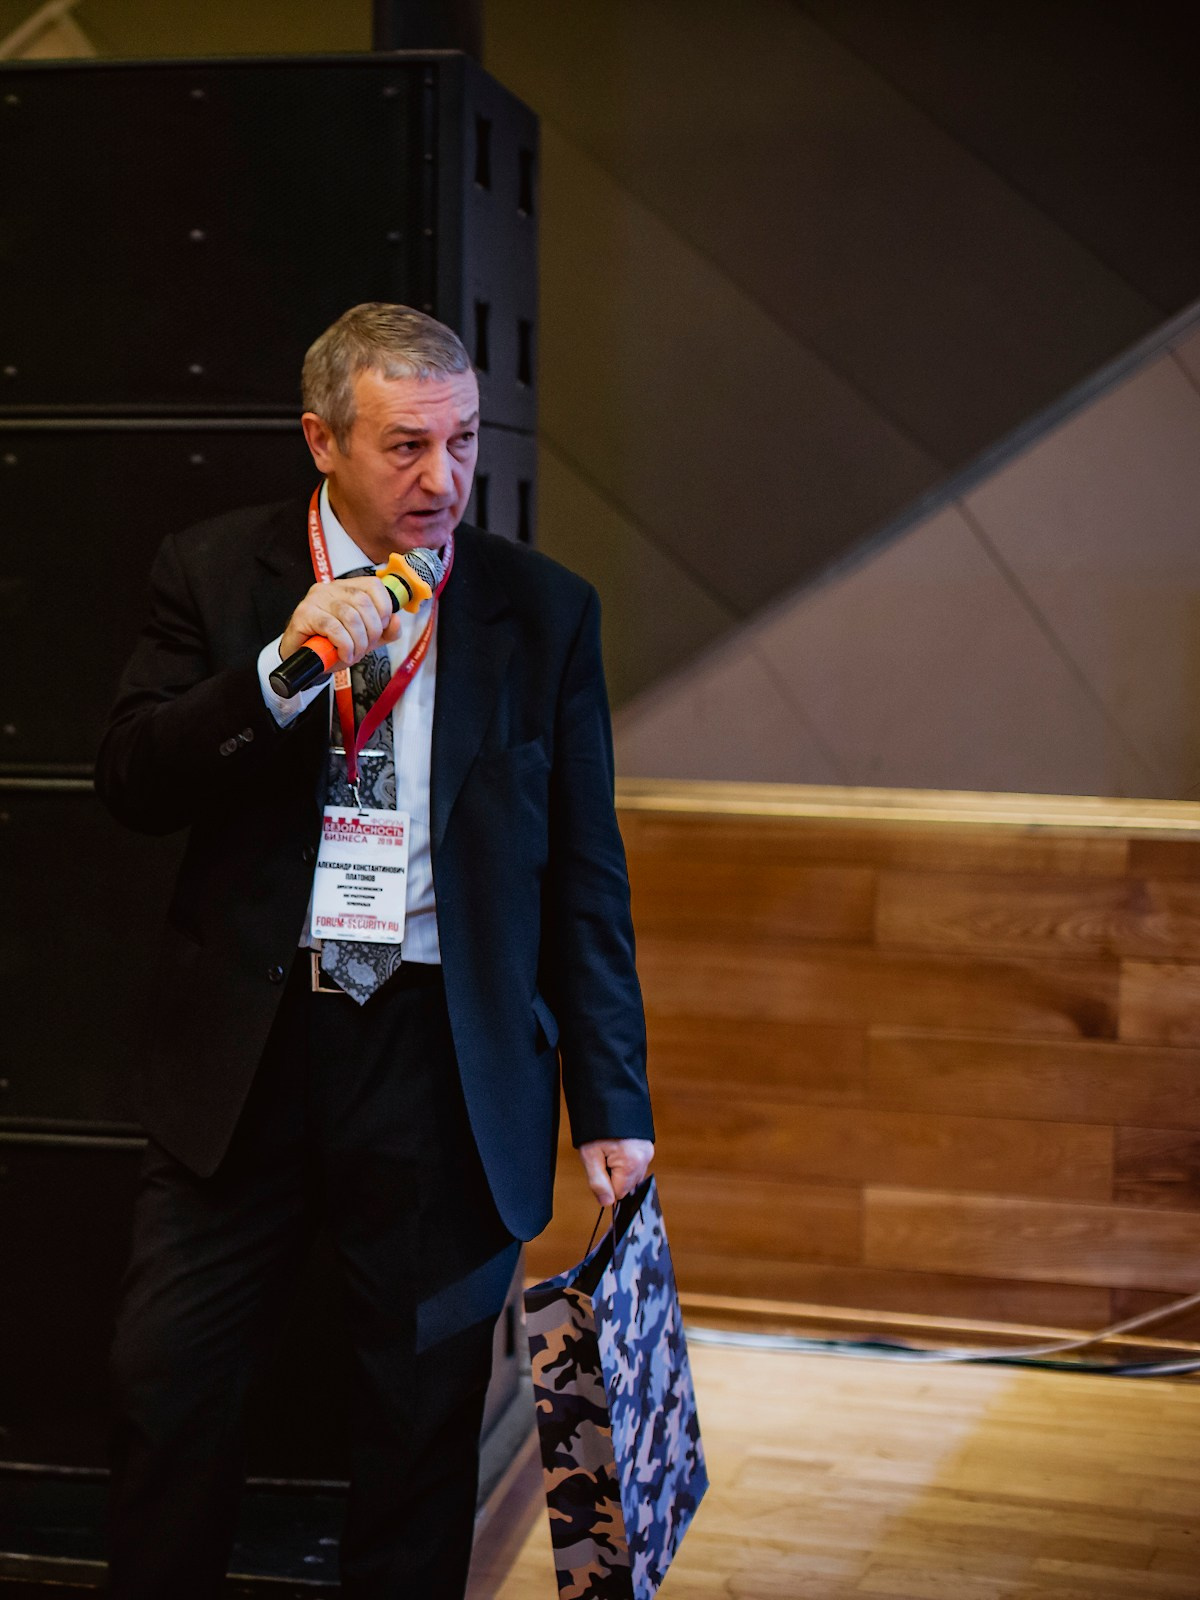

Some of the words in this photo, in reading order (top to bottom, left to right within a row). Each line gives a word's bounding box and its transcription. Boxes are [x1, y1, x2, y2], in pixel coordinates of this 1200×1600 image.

[324, 822, 404, 837] БЕЗОПАСНОСТЬ
[324, 833, 368, 844] БИЗНЕСА
[317, 861, 352, 871] АЛЕКСАНДР
[352, 863, 405, 875] КОНСТАНТИНОВИЧ
[345, 872, 376, 882] ПЛАТОНОВ
